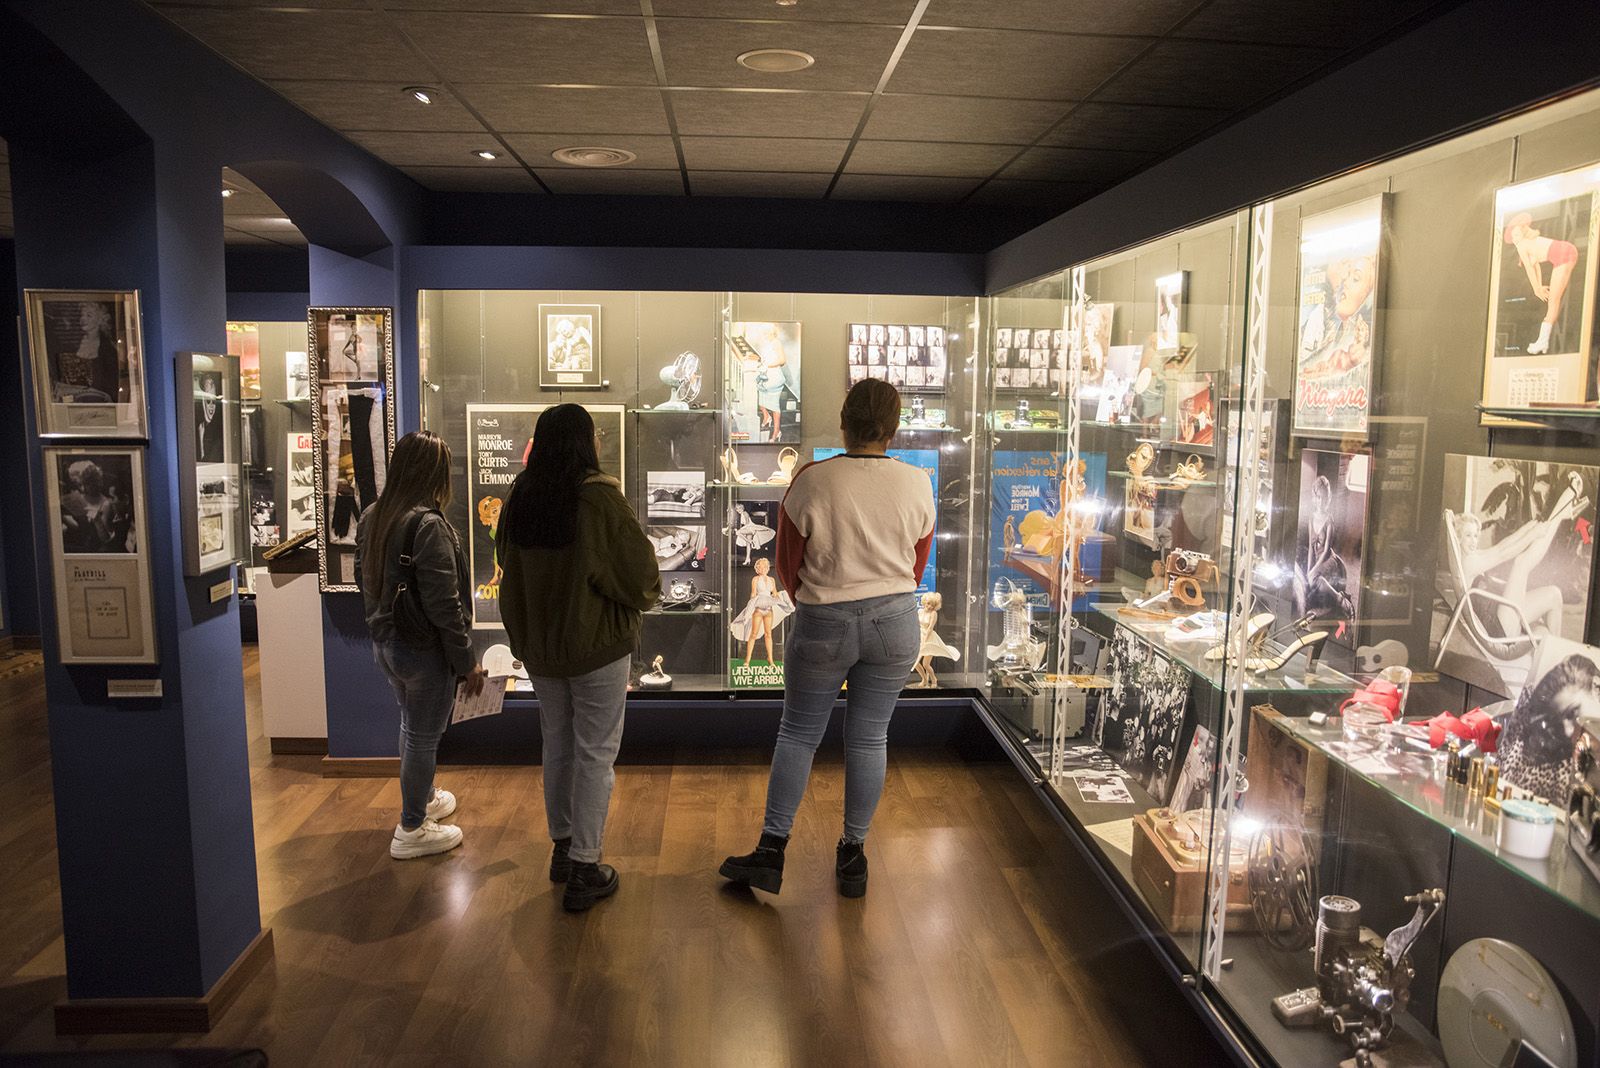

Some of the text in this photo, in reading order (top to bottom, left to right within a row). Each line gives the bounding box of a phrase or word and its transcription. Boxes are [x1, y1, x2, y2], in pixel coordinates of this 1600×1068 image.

[1297, 378, 1367, 416] Niagara
[478, 439, 513, 451] MONROE
[478, 457, 509, 468] CURTIS
[733, 675, 784, 685] VIVE ARRIBA
